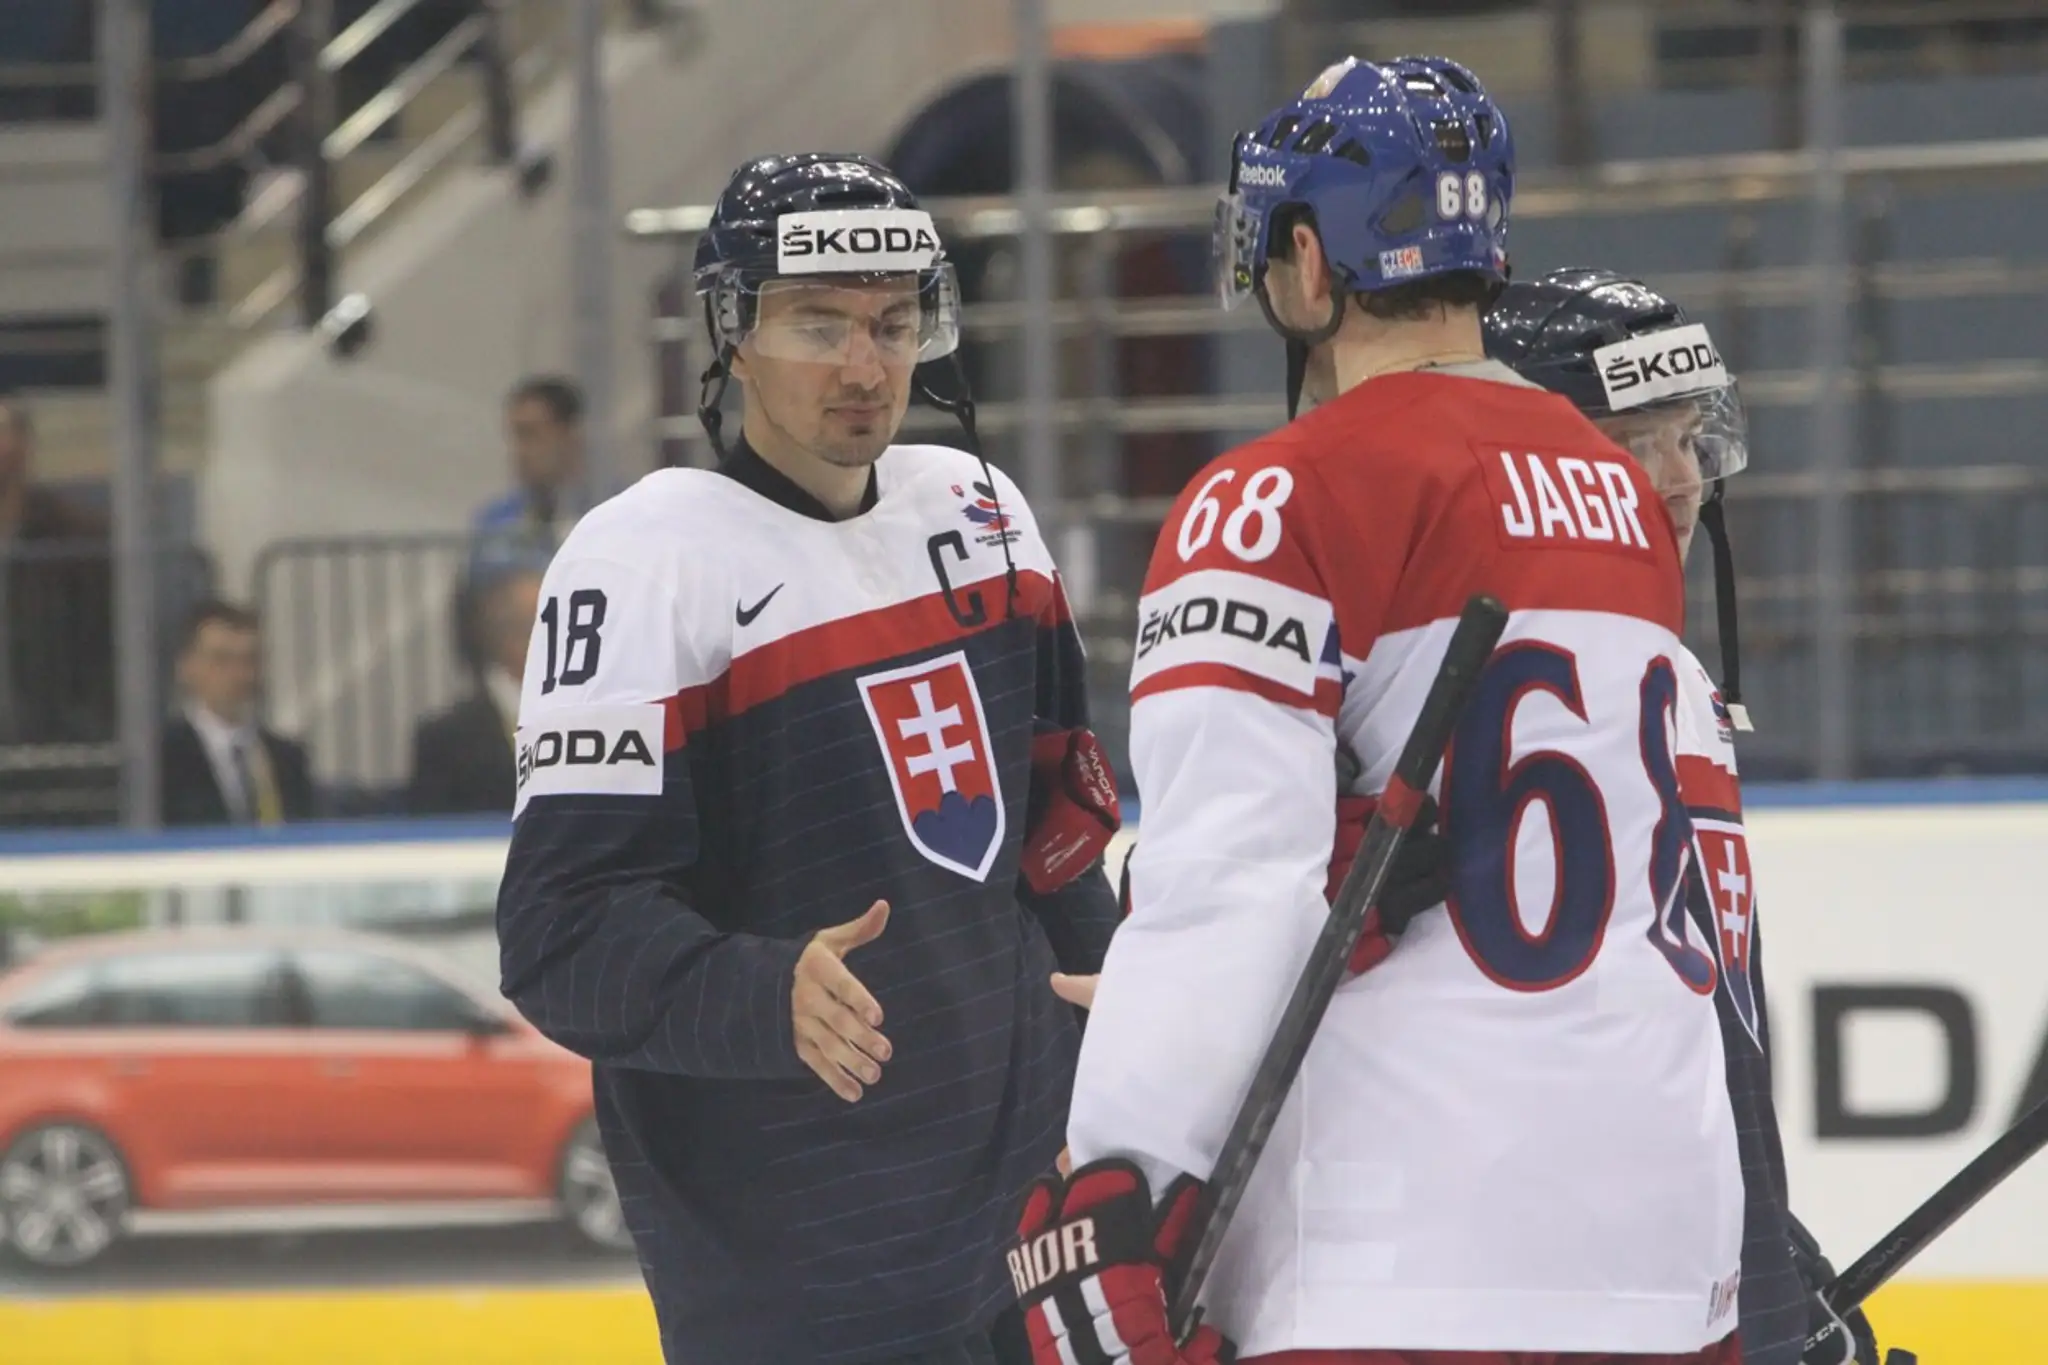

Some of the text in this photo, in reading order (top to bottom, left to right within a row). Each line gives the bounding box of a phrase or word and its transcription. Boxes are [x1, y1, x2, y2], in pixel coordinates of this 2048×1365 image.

[1239, 161, 1286, 187] Reebok
[1436, 170, 1488, 220] 68
[782, 224, 937, 257] ŠKODA
[1177, 465, 1294, 563] 68
[1500, 450, 1650, 550] JAGR
[927, 529, 988, 629] C
[540, 588, 608, 696] 18
[1137, 597, 1312, 664] ŠKODA
[1005, 1217, 1099, 1298] RIOR
